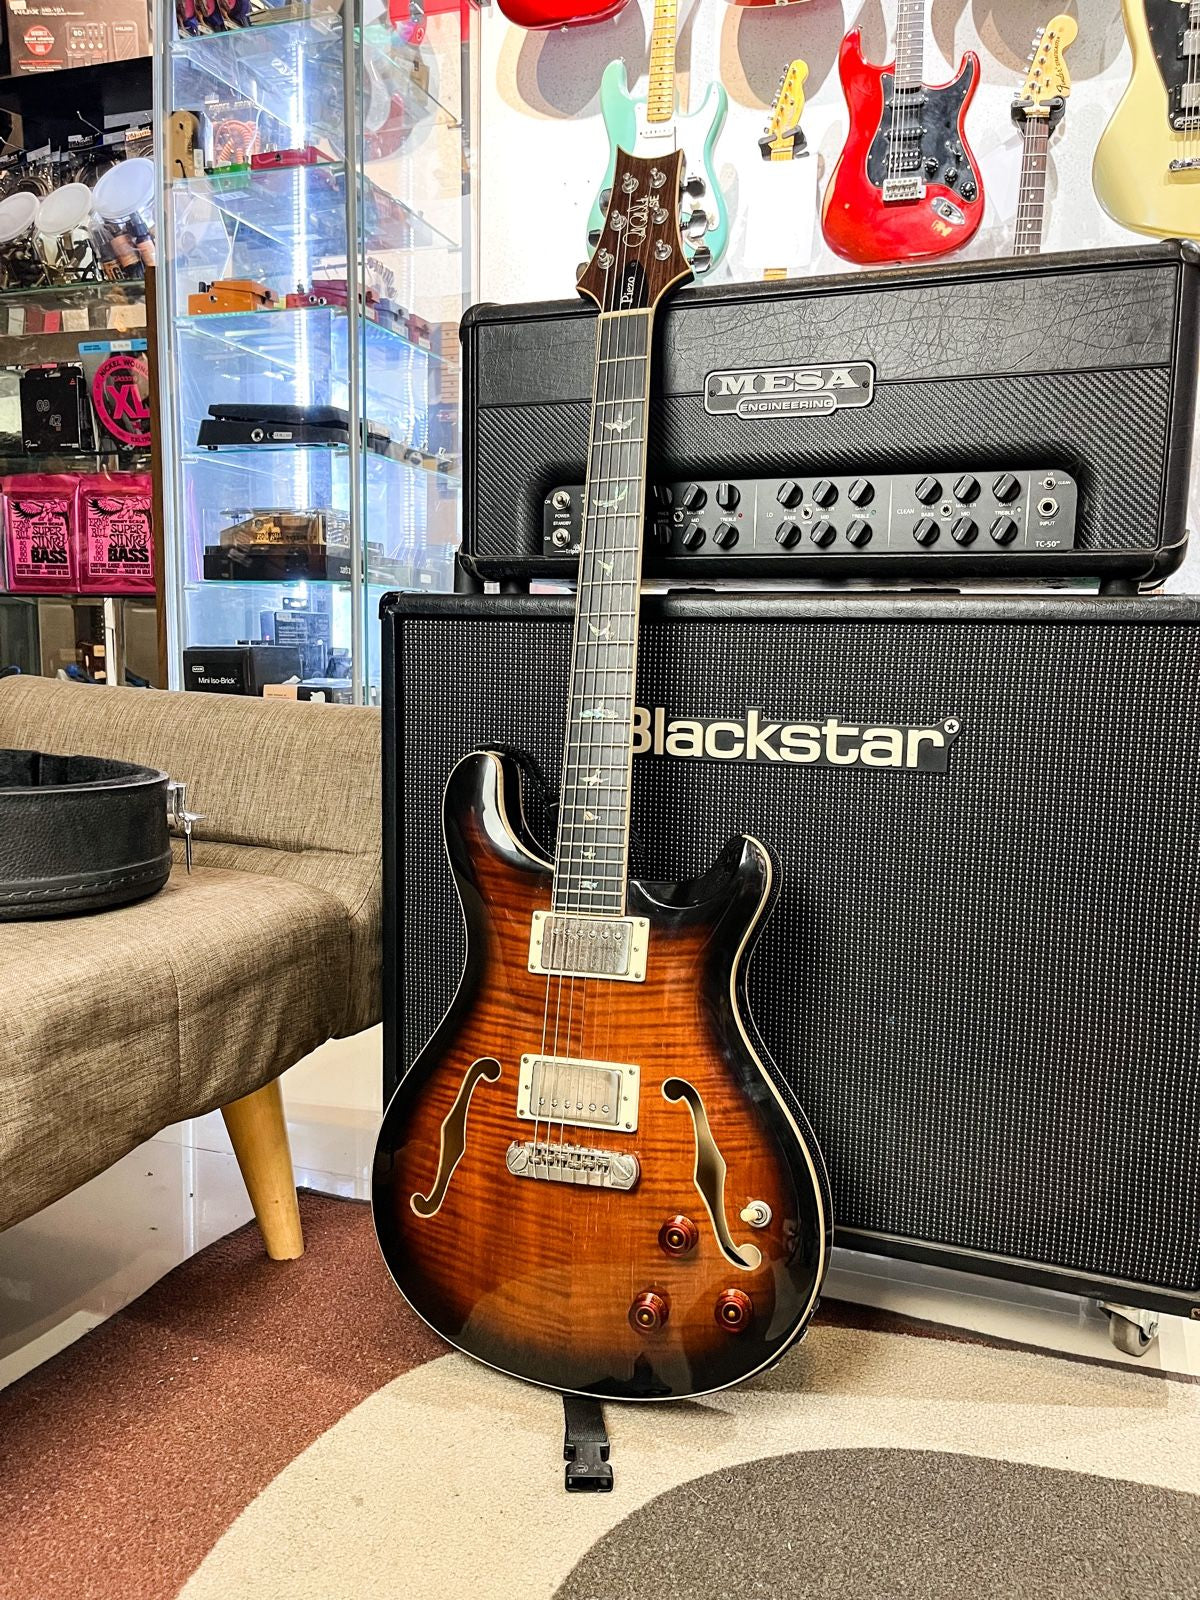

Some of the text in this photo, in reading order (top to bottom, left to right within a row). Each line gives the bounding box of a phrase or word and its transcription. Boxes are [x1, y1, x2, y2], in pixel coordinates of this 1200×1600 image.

[620, 276, 636, 304] Piezo
[99, 359, 121, 376] NICKEL
[716, 368, 861, 396] MESA
[36, 399, 50, 412] 09
[106, 384, 151, 419] XL
[739, 399, 834, 412] ENGINEERING
[88, 517, 110, 528] ERNIE
[111, 524, 147, 534] SUPER
[32, 526, 63, 536] SUPER
[32, 533, 67, 550] SLINKY
[109, 534, 147, 549] SLINKY
[31, 549, 68, 564] BASS
[108, 547, 149, 563] BASS
